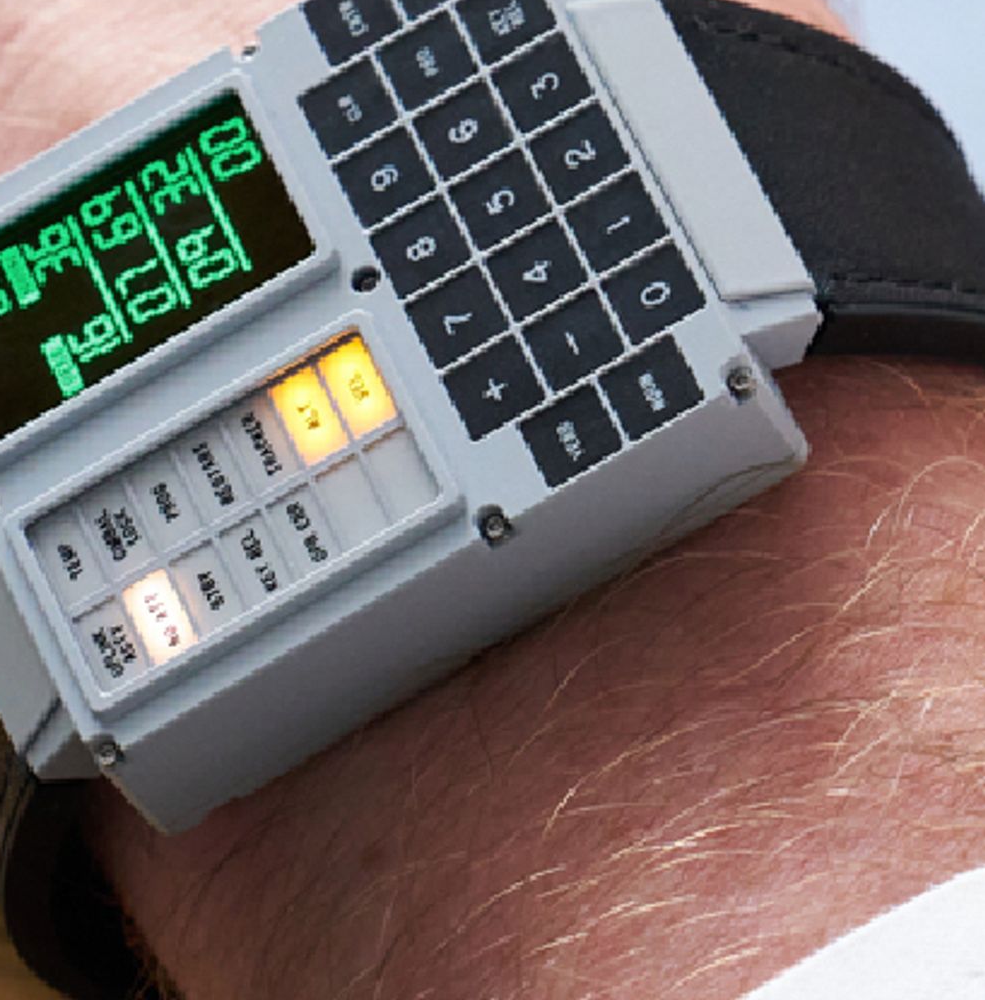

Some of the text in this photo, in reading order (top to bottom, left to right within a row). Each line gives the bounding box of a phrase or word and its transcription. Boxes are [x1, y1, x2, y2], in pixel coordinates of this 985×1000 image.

[530, 72, 559, 100] 3
[448, 118, 479, 144] 6
[198, 116, 262, 182] 00
[564, 139, 597, 170] 2
[370, 164, 399, 192] 9
[485, 189, 515, 215] 5
[139, 149, 237, 289] 09 32
[606, 215, 631, 235] 1
[22, 222, 82, 285] 36
[79, 186, 180, 325] 07 69
[406, 236, 437, 262] 8
[522, 260, 549, 282] 4
[640, 281, 671, 306] 0
[443, 312, 473, 335] 7
